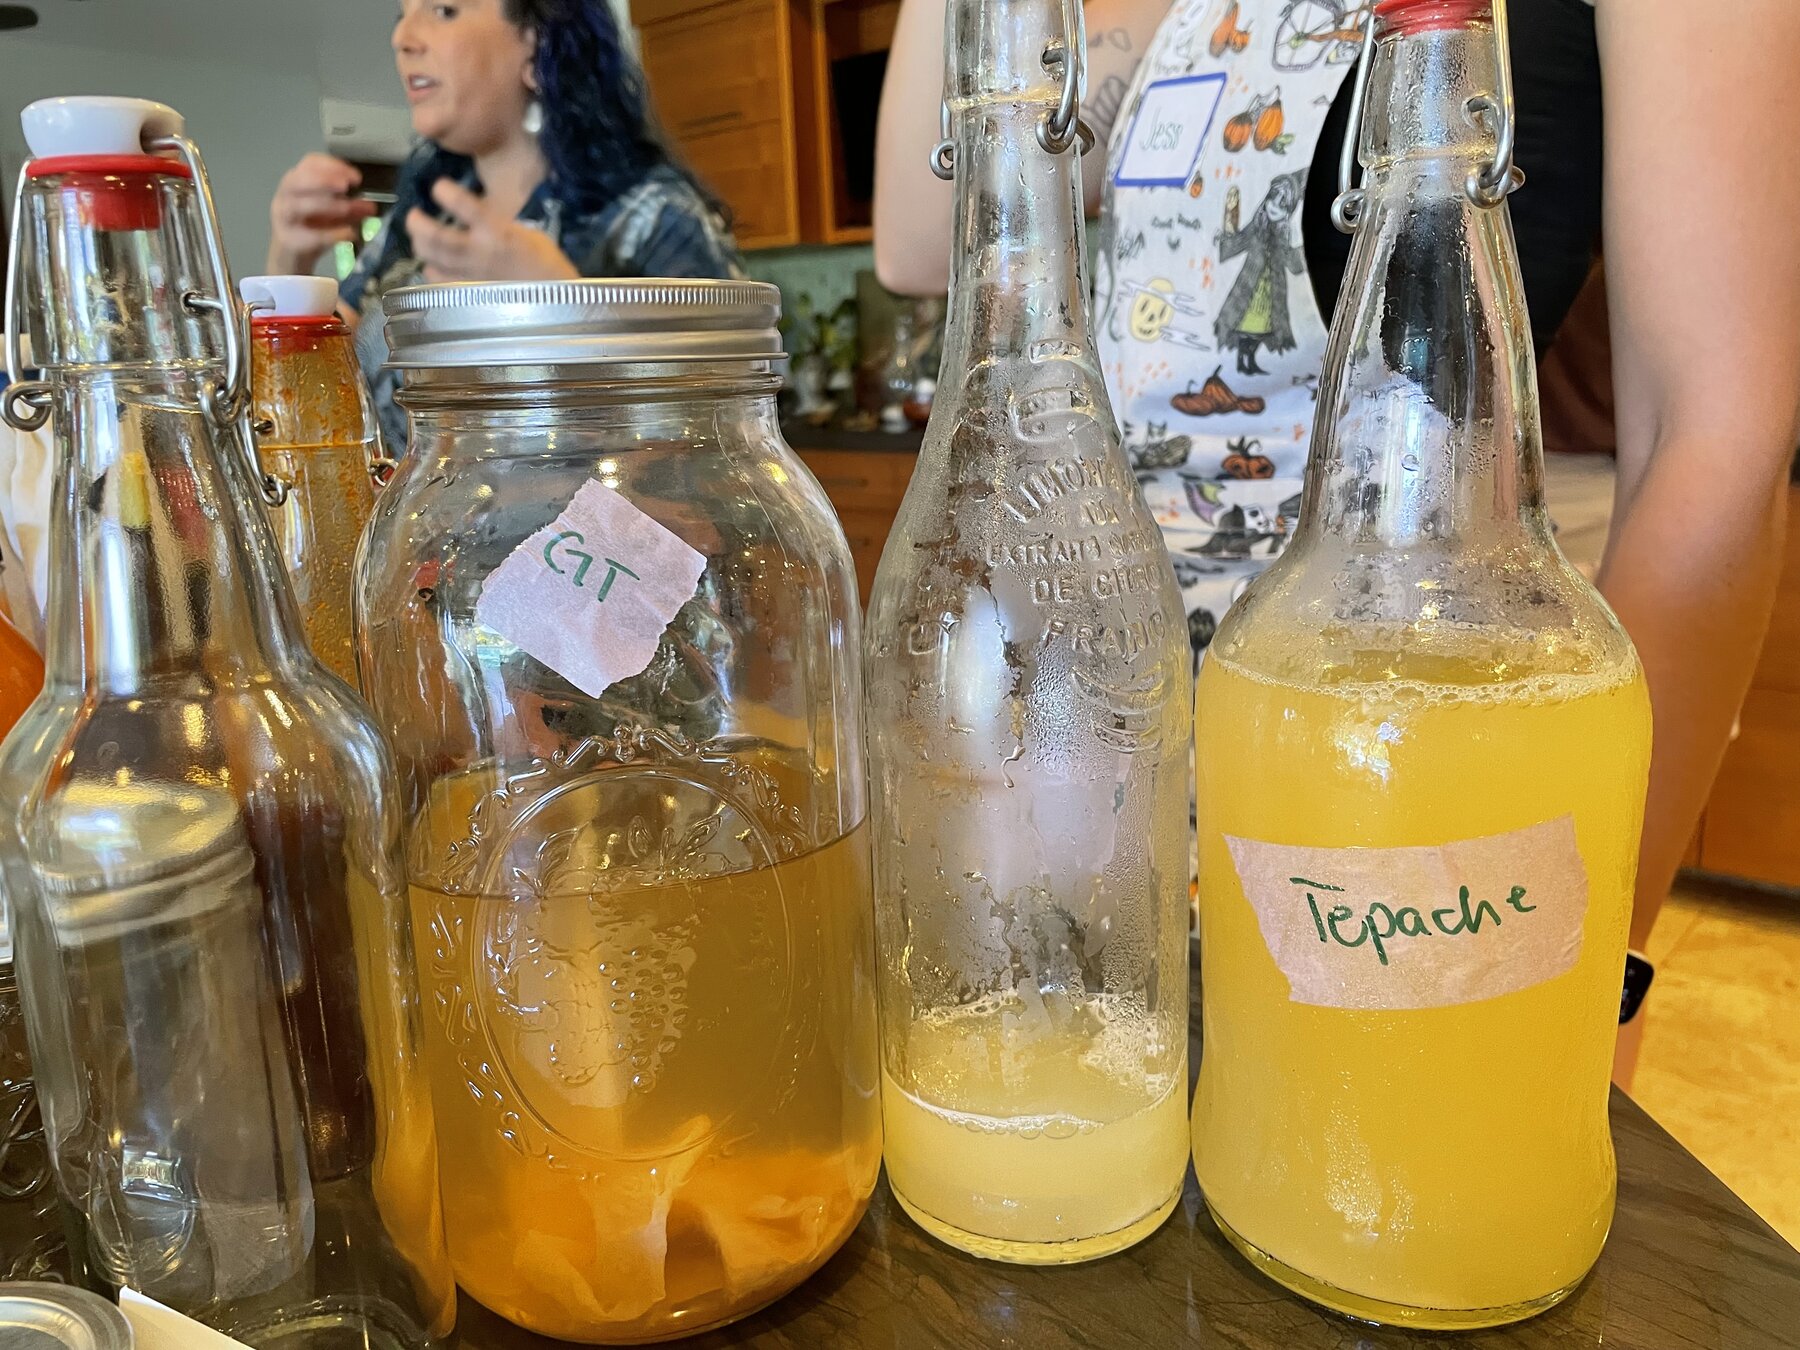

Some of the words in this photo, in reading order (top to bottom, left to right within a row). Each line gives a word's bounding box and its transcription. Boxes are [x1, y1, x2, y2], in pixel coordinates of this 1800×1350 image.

[1139, 106, 1184, 151] Jess
[543, 530, 640, 602] GT
[1289, 877, 1537, 966] Tepache
